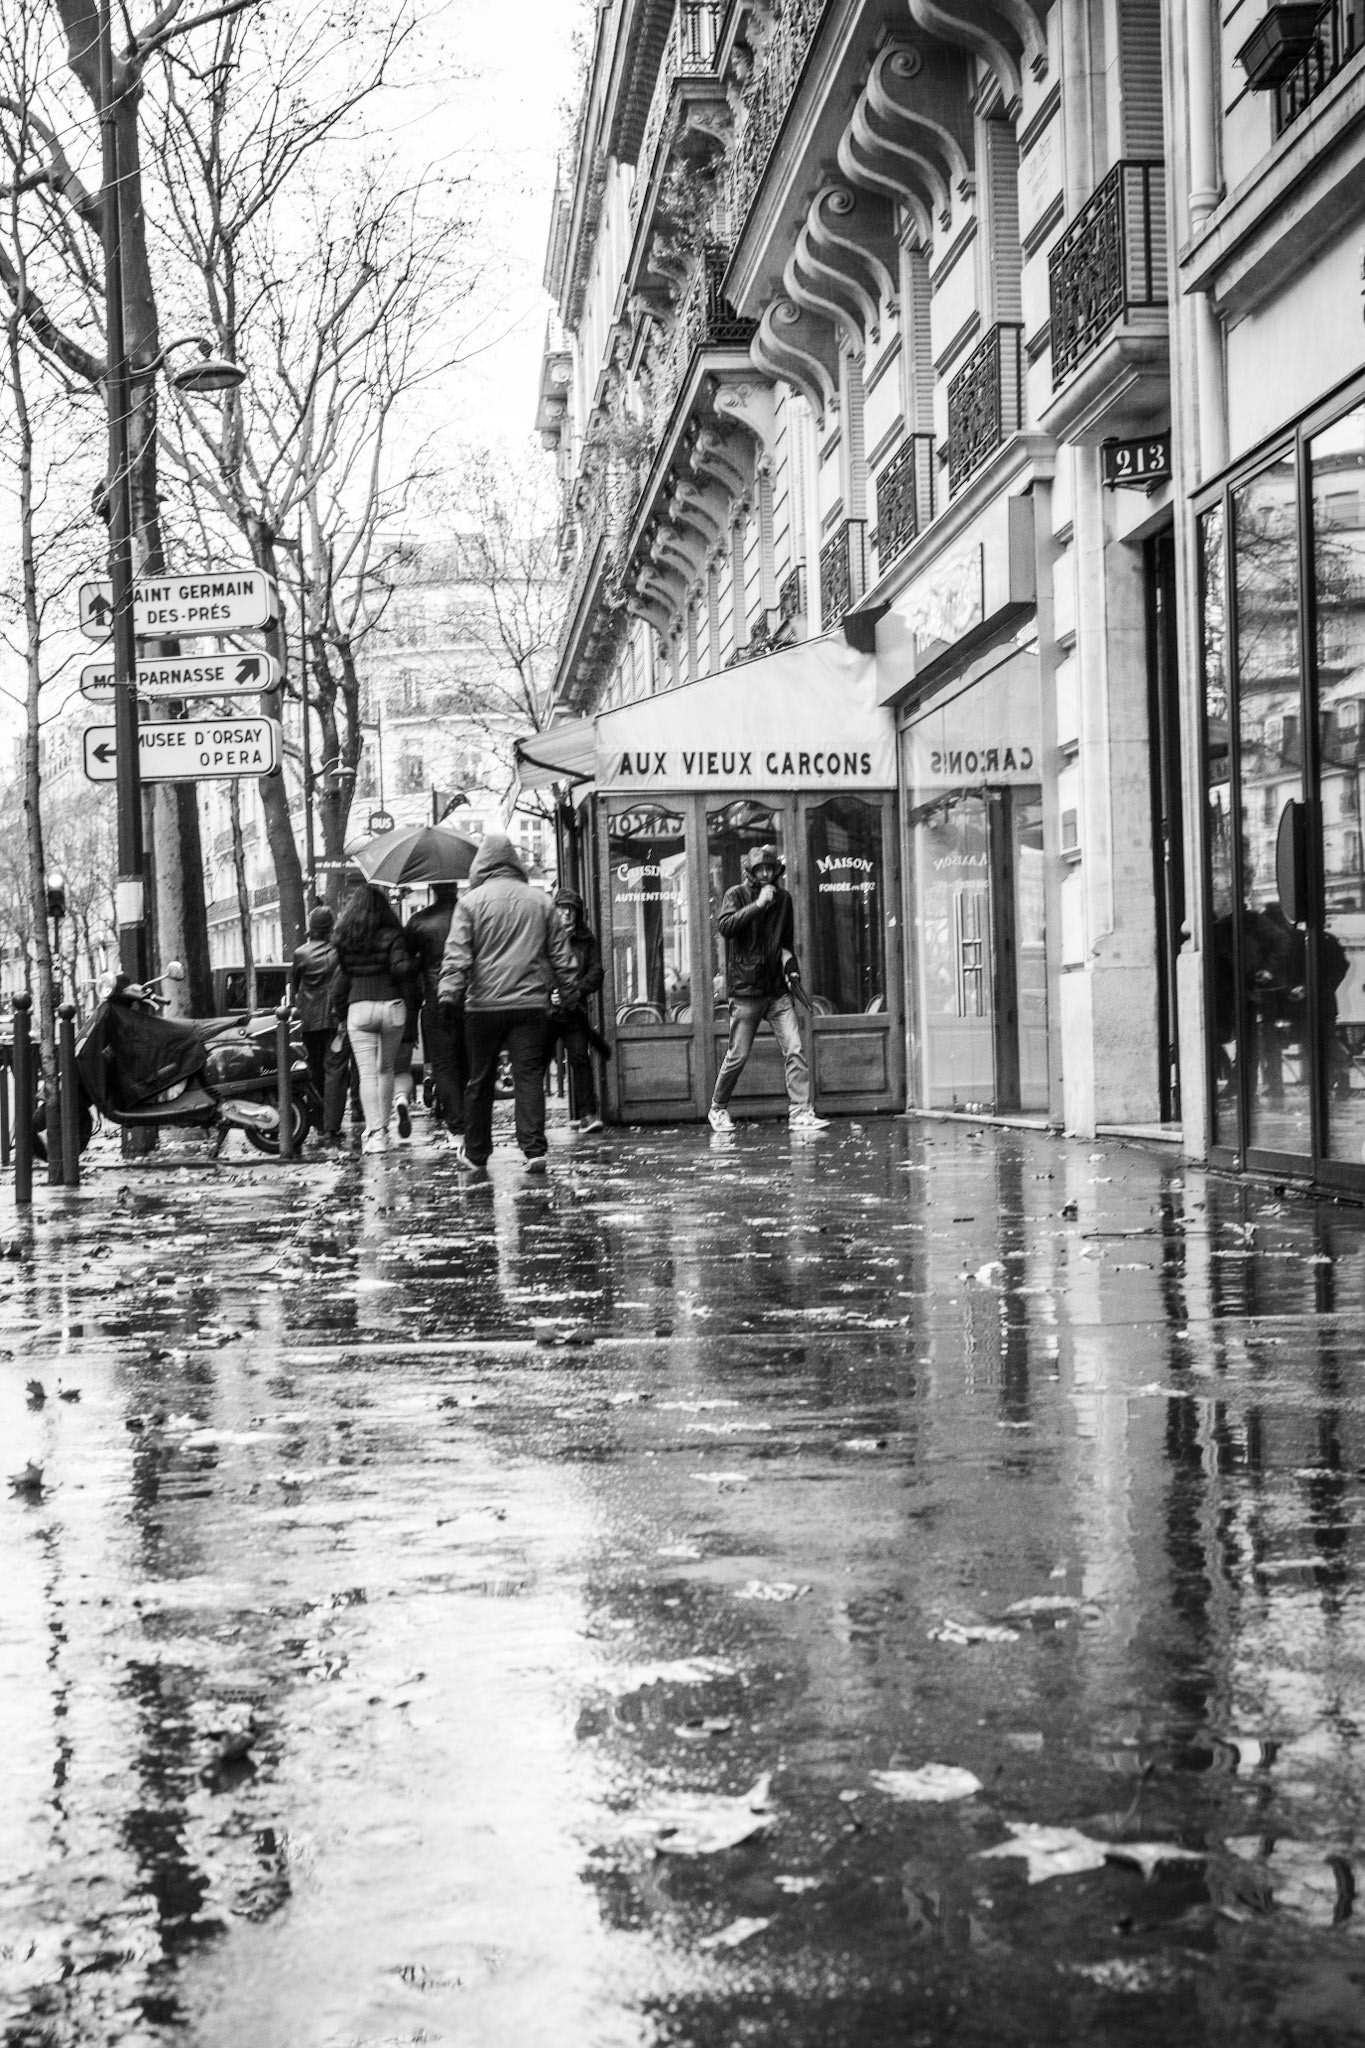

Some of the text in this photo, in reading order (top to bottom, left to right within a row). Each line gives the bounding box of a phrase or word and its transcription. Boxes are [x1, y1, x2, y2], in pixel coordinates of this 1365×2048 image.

[1116, 444, 1165, 476] 213
[134, 581, 254, 603] AINT GERMAIN
[147, 603, 231, 625] DES-PRÉS
[93, 666, 224, 690] MOPARNASSE
[199, 750, 263, 766] OPERA
[619, 751, 872, 778] AUX VIEUX GARÇONS
[371, 817, 392, 829] BUS
[816, 855, 874, 874] MAISON
